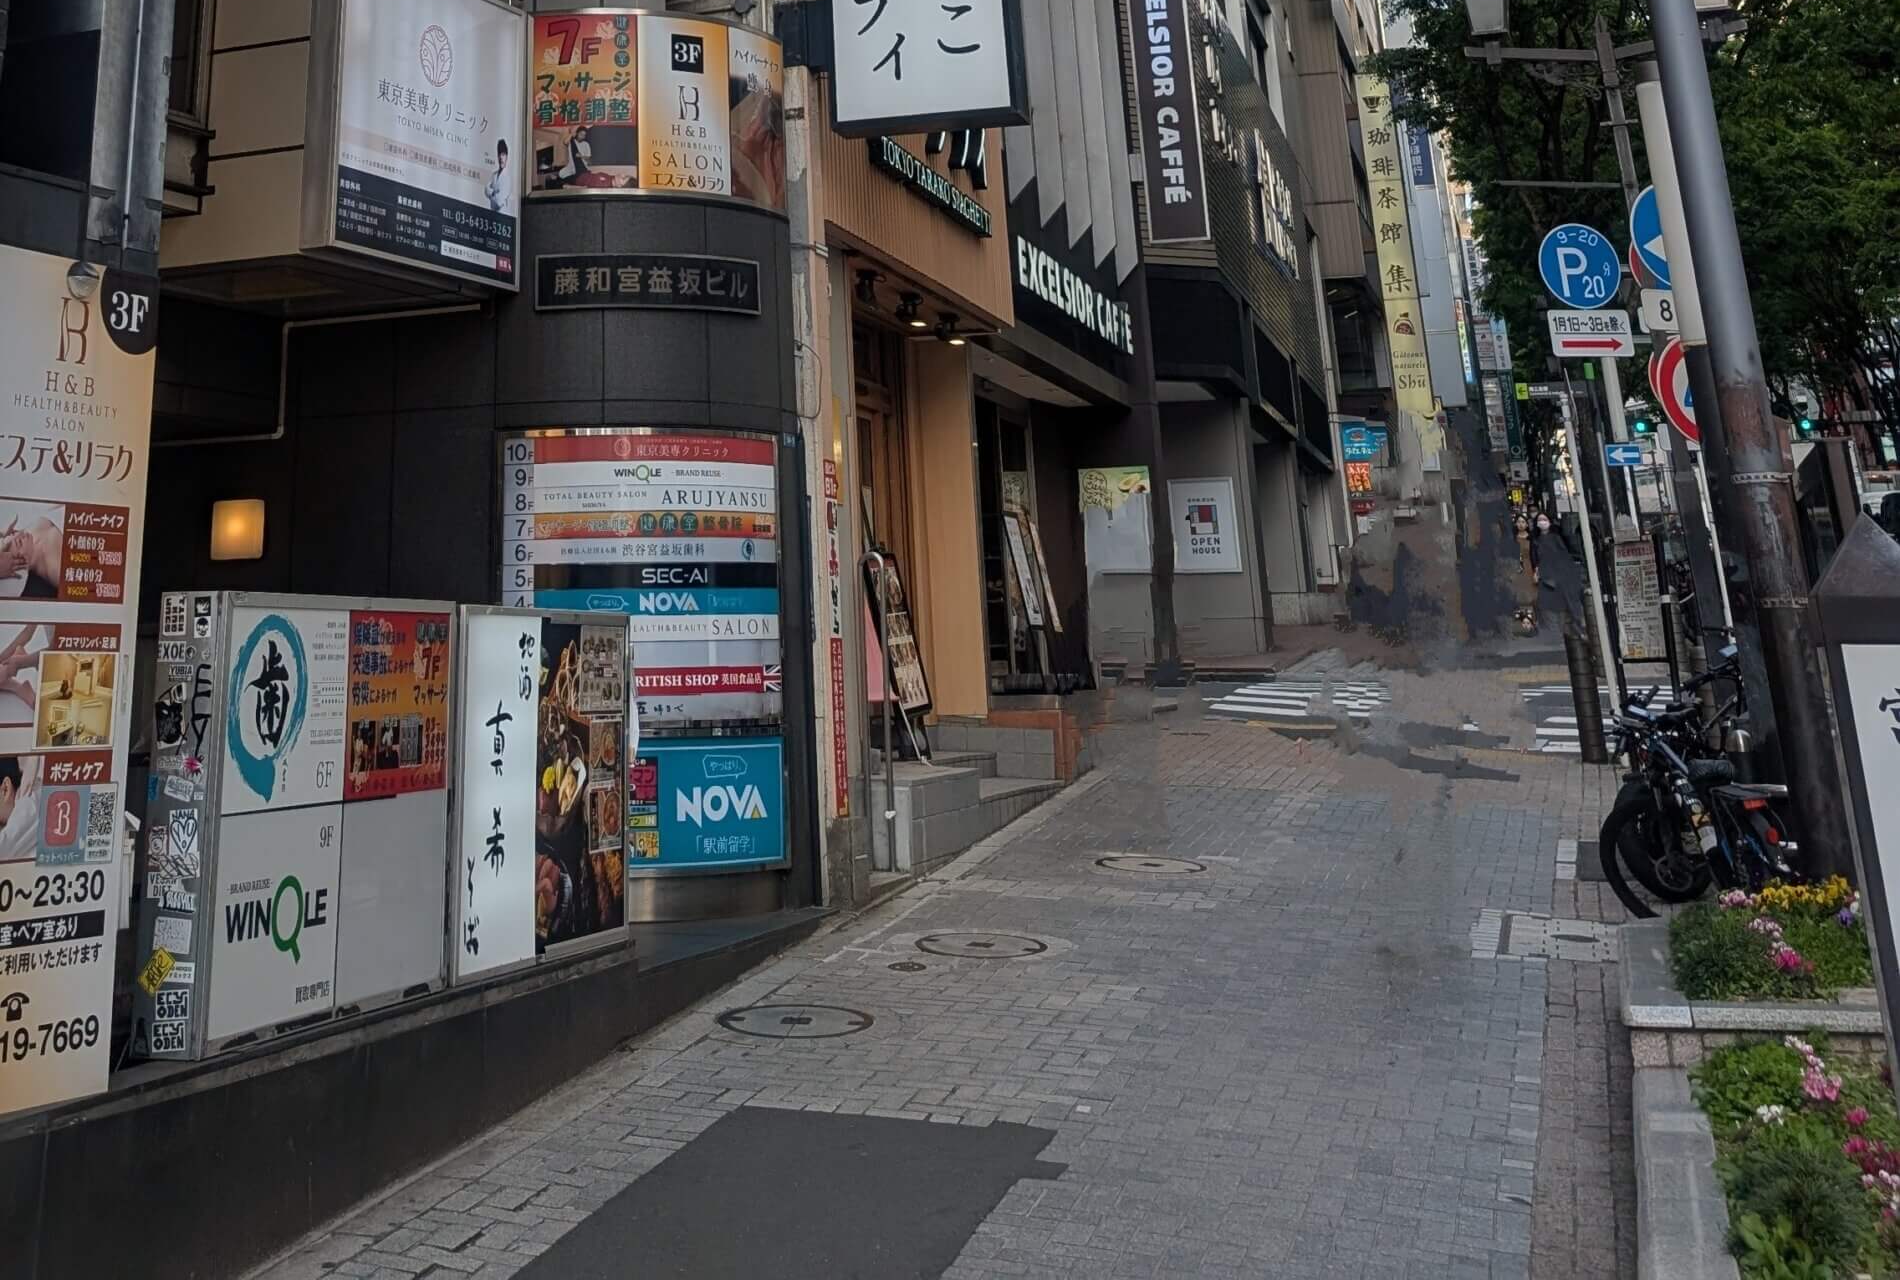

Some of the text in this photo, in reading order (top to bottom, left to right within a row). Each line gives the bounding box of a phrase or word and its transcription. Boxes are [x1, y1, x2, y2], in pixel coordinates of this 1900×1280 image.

[547, 18, 602, 66] 7F
[674, 41, 702, 64] 3F
[537, 71, 632, 94] マッサージ
[377, 78, 489, 134] 東京美専クリニック
[536, 98, 632, 123] 骨格調整
[397, 115, 421, 131] TOKYO
[652, 139, 723, 153] HEALTH&BEAUTY
[1156, 105, 1193, 205] CAFFÉ
[652, 151, 723, 172] SALON
[653, 173, 725, 192] エステ&リラク
[881, 135, 914, 178] TOKYO
[914, 160, 950, 205] TARAKO
[951, 186, 993, 236] SPAGHETTI
[1557, 230, 1599, 246] 9-20
[1556, 247, 1588, 297] P
[553, 266, 748, 299] 藤和宮益坂ビル
[1017, 235, 1096, 332] EXCELSIOR
[110, 290, 149, 333] 3F
[14, 393, 118, 419] HEALTH&BEAUTY
[45, 417, 86, 432] SALON
[506, 443, 534, 461] 10F
[636, 445, 729, 458] 東京美専クリニック
[514, 469, 534, 487] 9F
[614, 465, 662, 483] WINQLE
[514, 493, 535, 511] 8F
[544, 490, 648, 501] TOTAL BEAUTY SALON
[661, 489, 768, 508] ARUJYANSU
[515, 520, 534, 537] 7F
[622, 543, 705, 558] 渋谷宮益坂歯科
[1191, 537, 1221, 546] OPEN
[1192, 547, 1222, 555] HOUSE
[514, 544, 534, 561] 6F
[514, 571, 534, 587] 5F
[642, 568, 708, 584] SEC-AI
[639, 592, 700, 614] NOVA
[712, 618, 770, 635] SALON
[422, 647, 441, 681] 7F
[636, 672, 762, 688] RITISH SHOP 英国食品店
[316, 761, 335, 789] 6F
[676, 784, 768, 829] NOVA
[319, 826, 334, 849] 9F
[230, 878, 271, 896] BRAND REUSE
[225, 875, 328, 965] WINQLE
